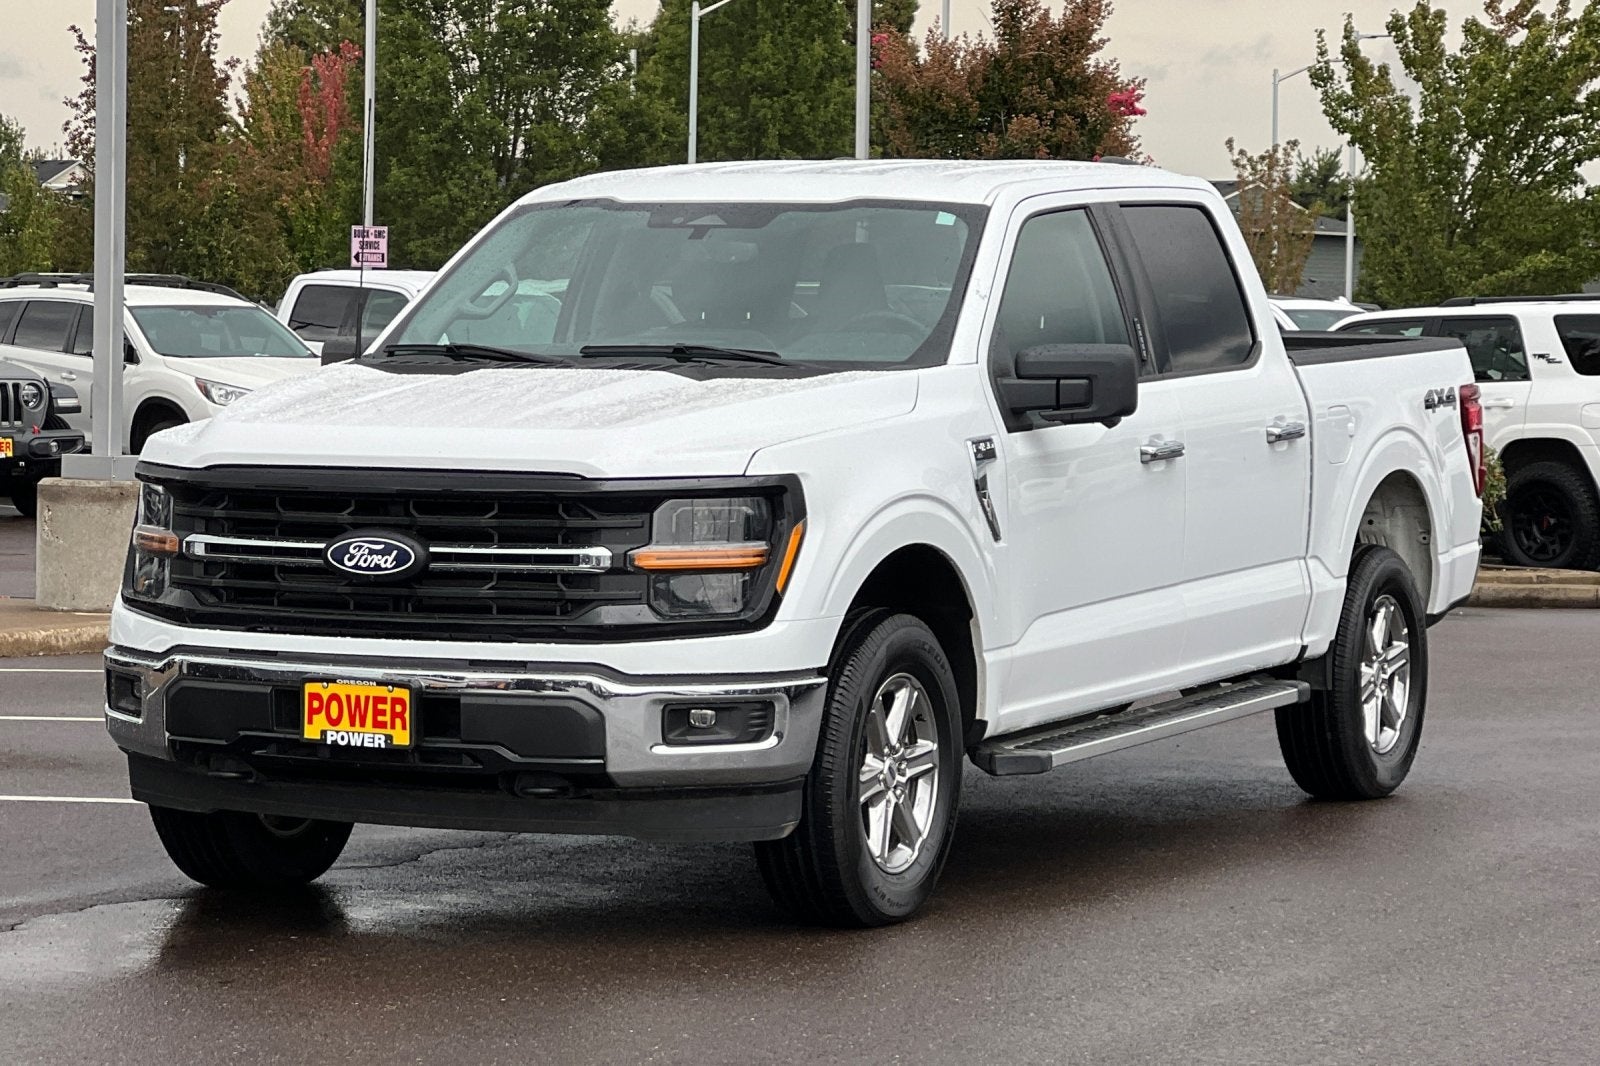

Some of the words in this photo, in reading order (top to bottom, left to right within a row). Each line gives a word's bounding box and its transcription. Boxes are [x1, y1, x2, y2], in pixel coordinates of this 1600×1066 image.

[374, 230, 386, 239] GMC
[358, 241, 381, 250] SERVICE
[343, 541, 398, 568] Ford
[336, 678, 377, 687] OREGON
[306, 692, 407, 731] POWER
[326, 730, 386, 748] POWER
